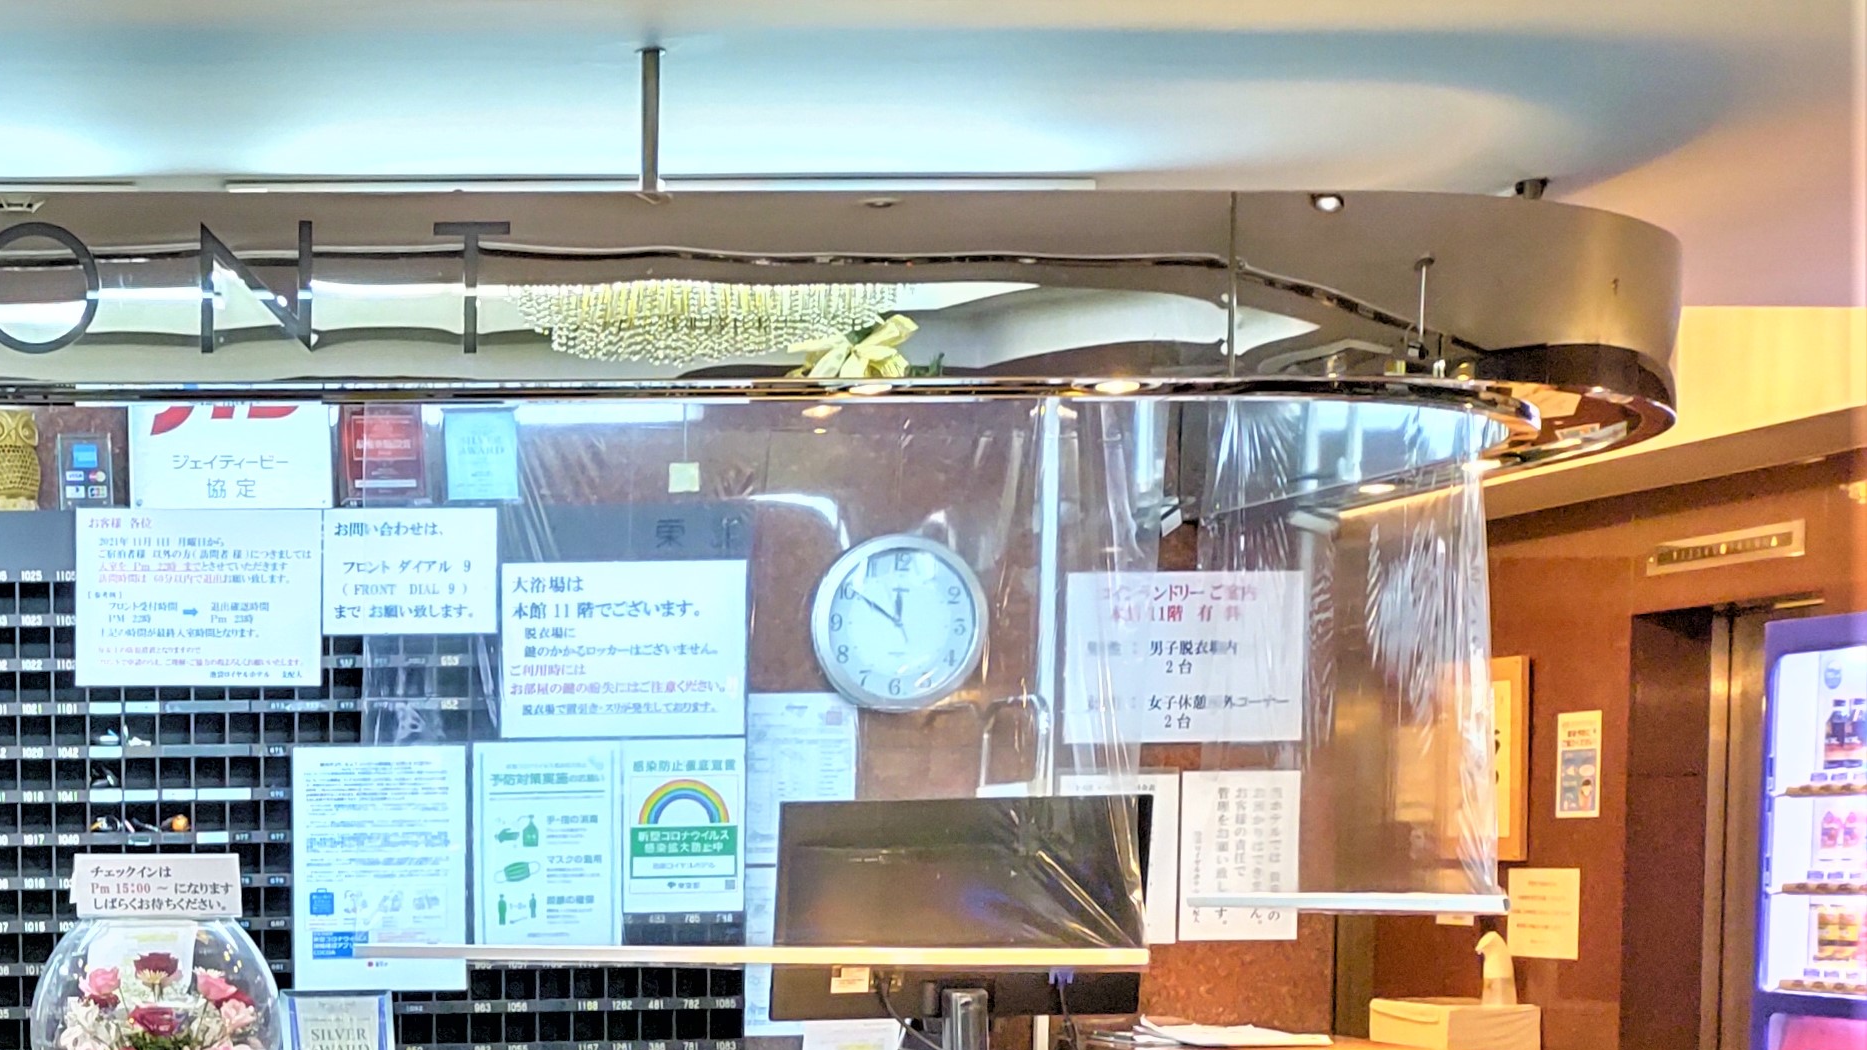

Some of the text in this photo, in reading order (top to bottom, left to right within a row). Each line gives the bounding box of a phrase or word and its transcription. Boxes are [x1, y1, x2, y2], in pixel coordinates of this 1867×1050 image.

[172, 454, 289, 470] ジェイティービー
[206, 479, 257, 498] 協定
[88, 518, 152, 529] お客様 各位
[334, 522, 443, 537] お問い合わせは、
[343, 560, 471, 574] フロント ダイアル 9
[894, 553, 911, 571] 12
[410, 584, 439, 595] DIAL
[513, 577, 584, 593] 大浴場は
[948, 586, 961, 604] 2
[334, 604, 475, 619] まで お願い致します。
[513, 600, 700, 618] 本館 11 階でございます。
[831, 614, 842, 631] 9
[954, 618, 966, 636] 3
[525, 627, 576, 639] 脱衣場に
[525, 644, 718, 657] 鍵のかかるロッカーはございません。
[836, 645, 849, 663] 8
[943, 650, 956, 666] 4
[510, 664, 585, 676] ご利用時には
[859, 670, 871, 687] 7
[889, 678, 901, 695] 6
[91, 866, 172, 877] チェックインは
[91, 883, 233, 894] Pm 15:00 になります
[94, 898, 227, 911] しばらくお待ちください。
[311, 1028, 367, 1040] SILVER
